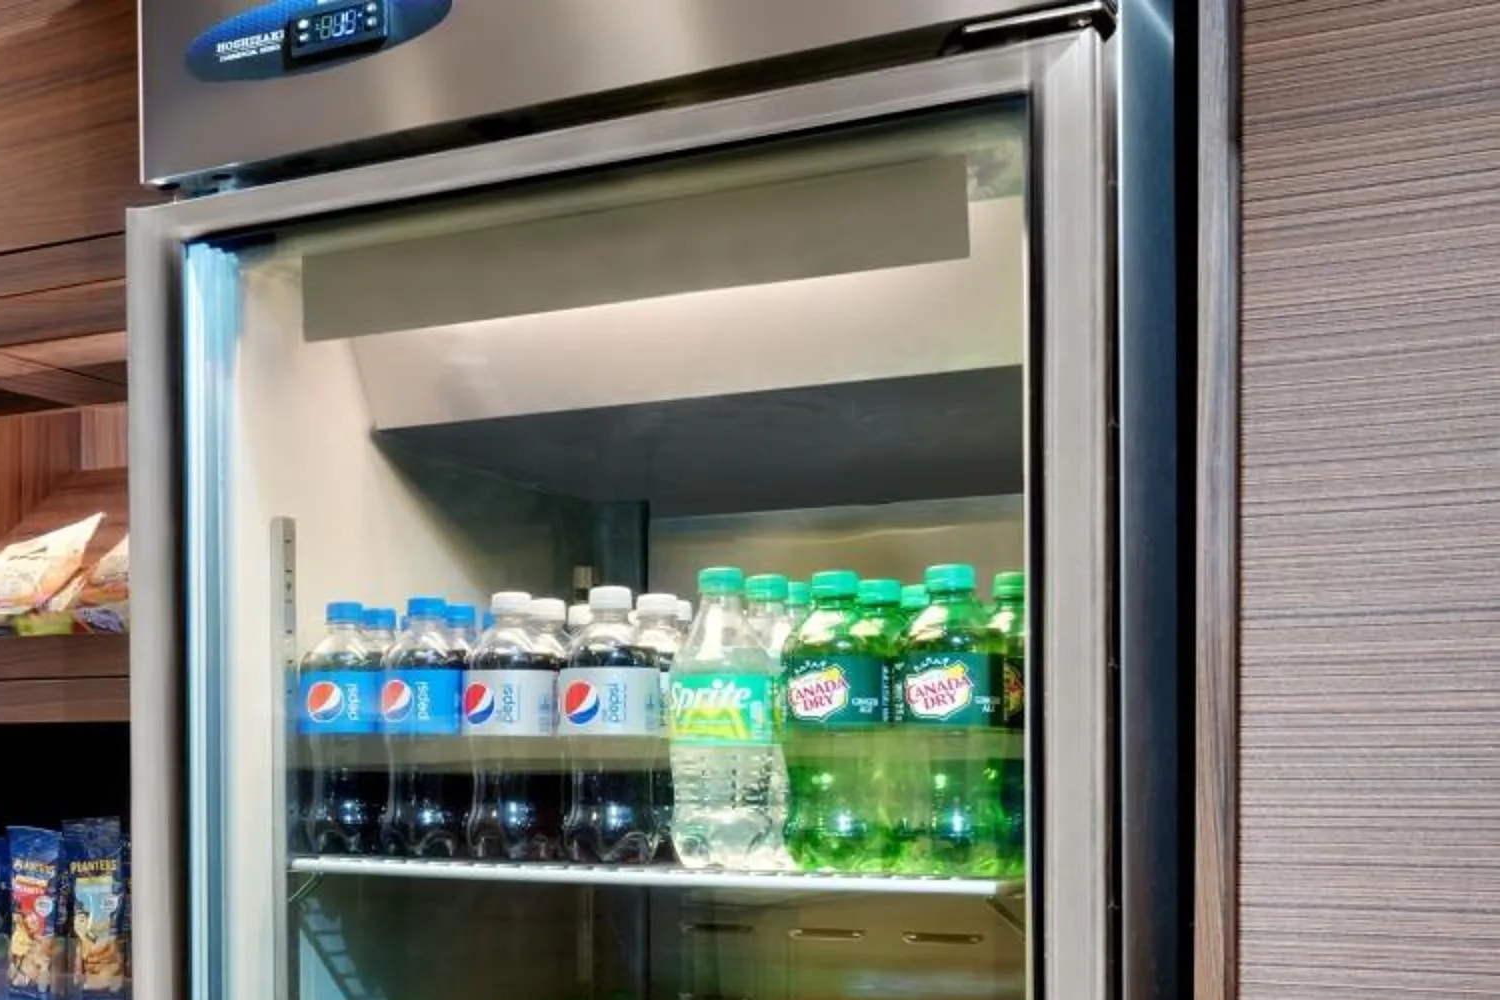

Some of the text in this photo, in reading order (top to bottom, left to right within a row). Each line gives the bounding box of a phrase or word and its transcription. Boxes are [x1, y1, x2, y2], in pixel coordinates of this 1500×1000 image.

[670, 679, 751, 717] Sprite
[789, 680, 848, 706] CANADA
[906, 676, 971, 705] CANADA
[923, 692, 957, 710] DRY
[802, 697, 834, 712] DRY
[70, 858, 117, 873] PLANTERS
